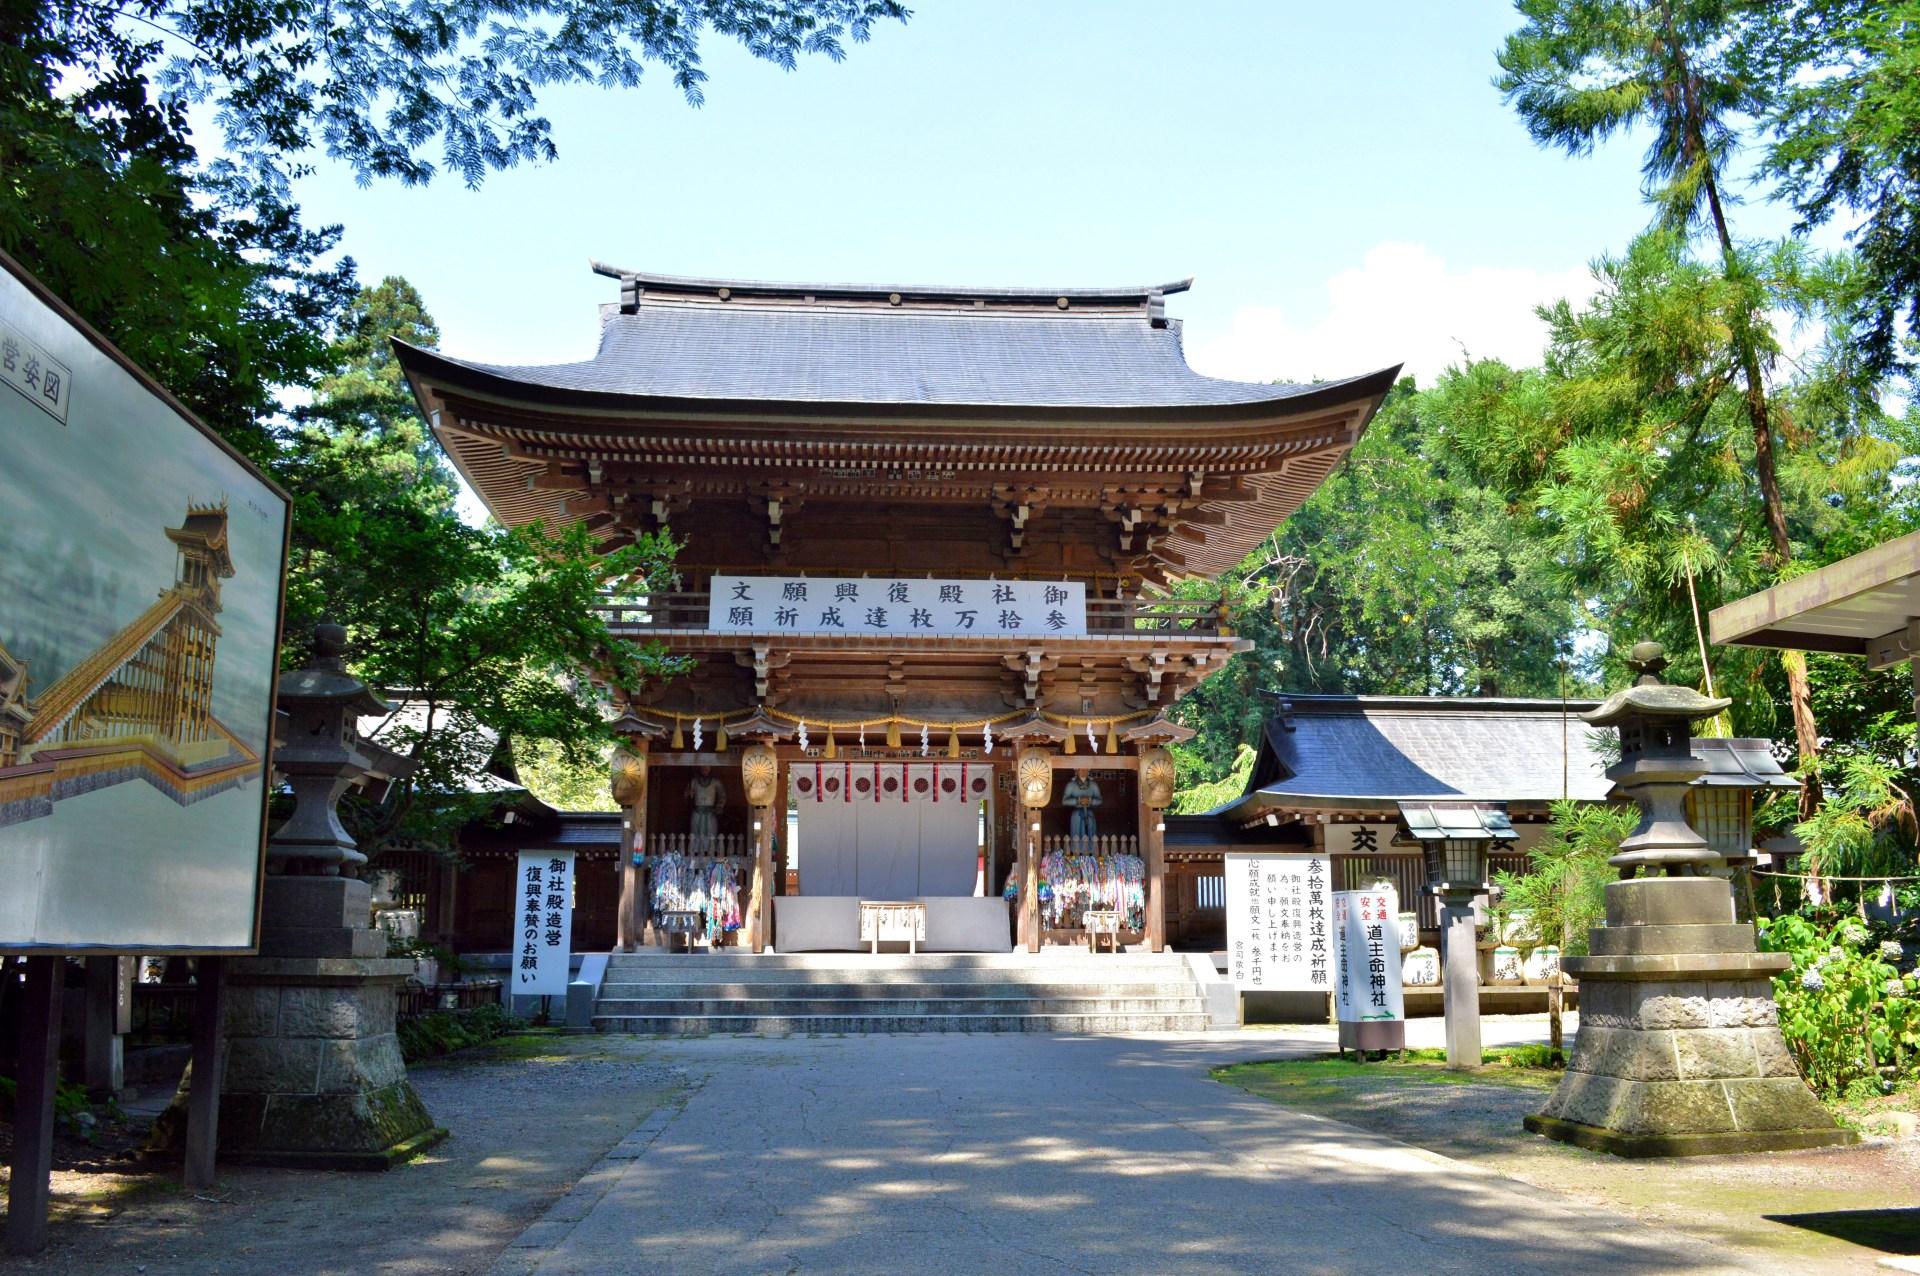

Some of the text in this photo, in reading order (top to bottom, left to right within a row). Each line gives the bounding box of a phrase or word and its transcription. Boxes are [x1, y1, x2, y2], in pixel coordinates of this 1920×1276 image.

[1351, 825, 1378, 852] 交
[520, 866, 543, 984] 復興奉賛のお願い
[545, 858, 566, 947] 御社殿造営
[1360, 896, 1372, 920] 安全
[1376, 896, 1388, 920] 交通
[1367, 924, 1387, 1007] 道主命神社
